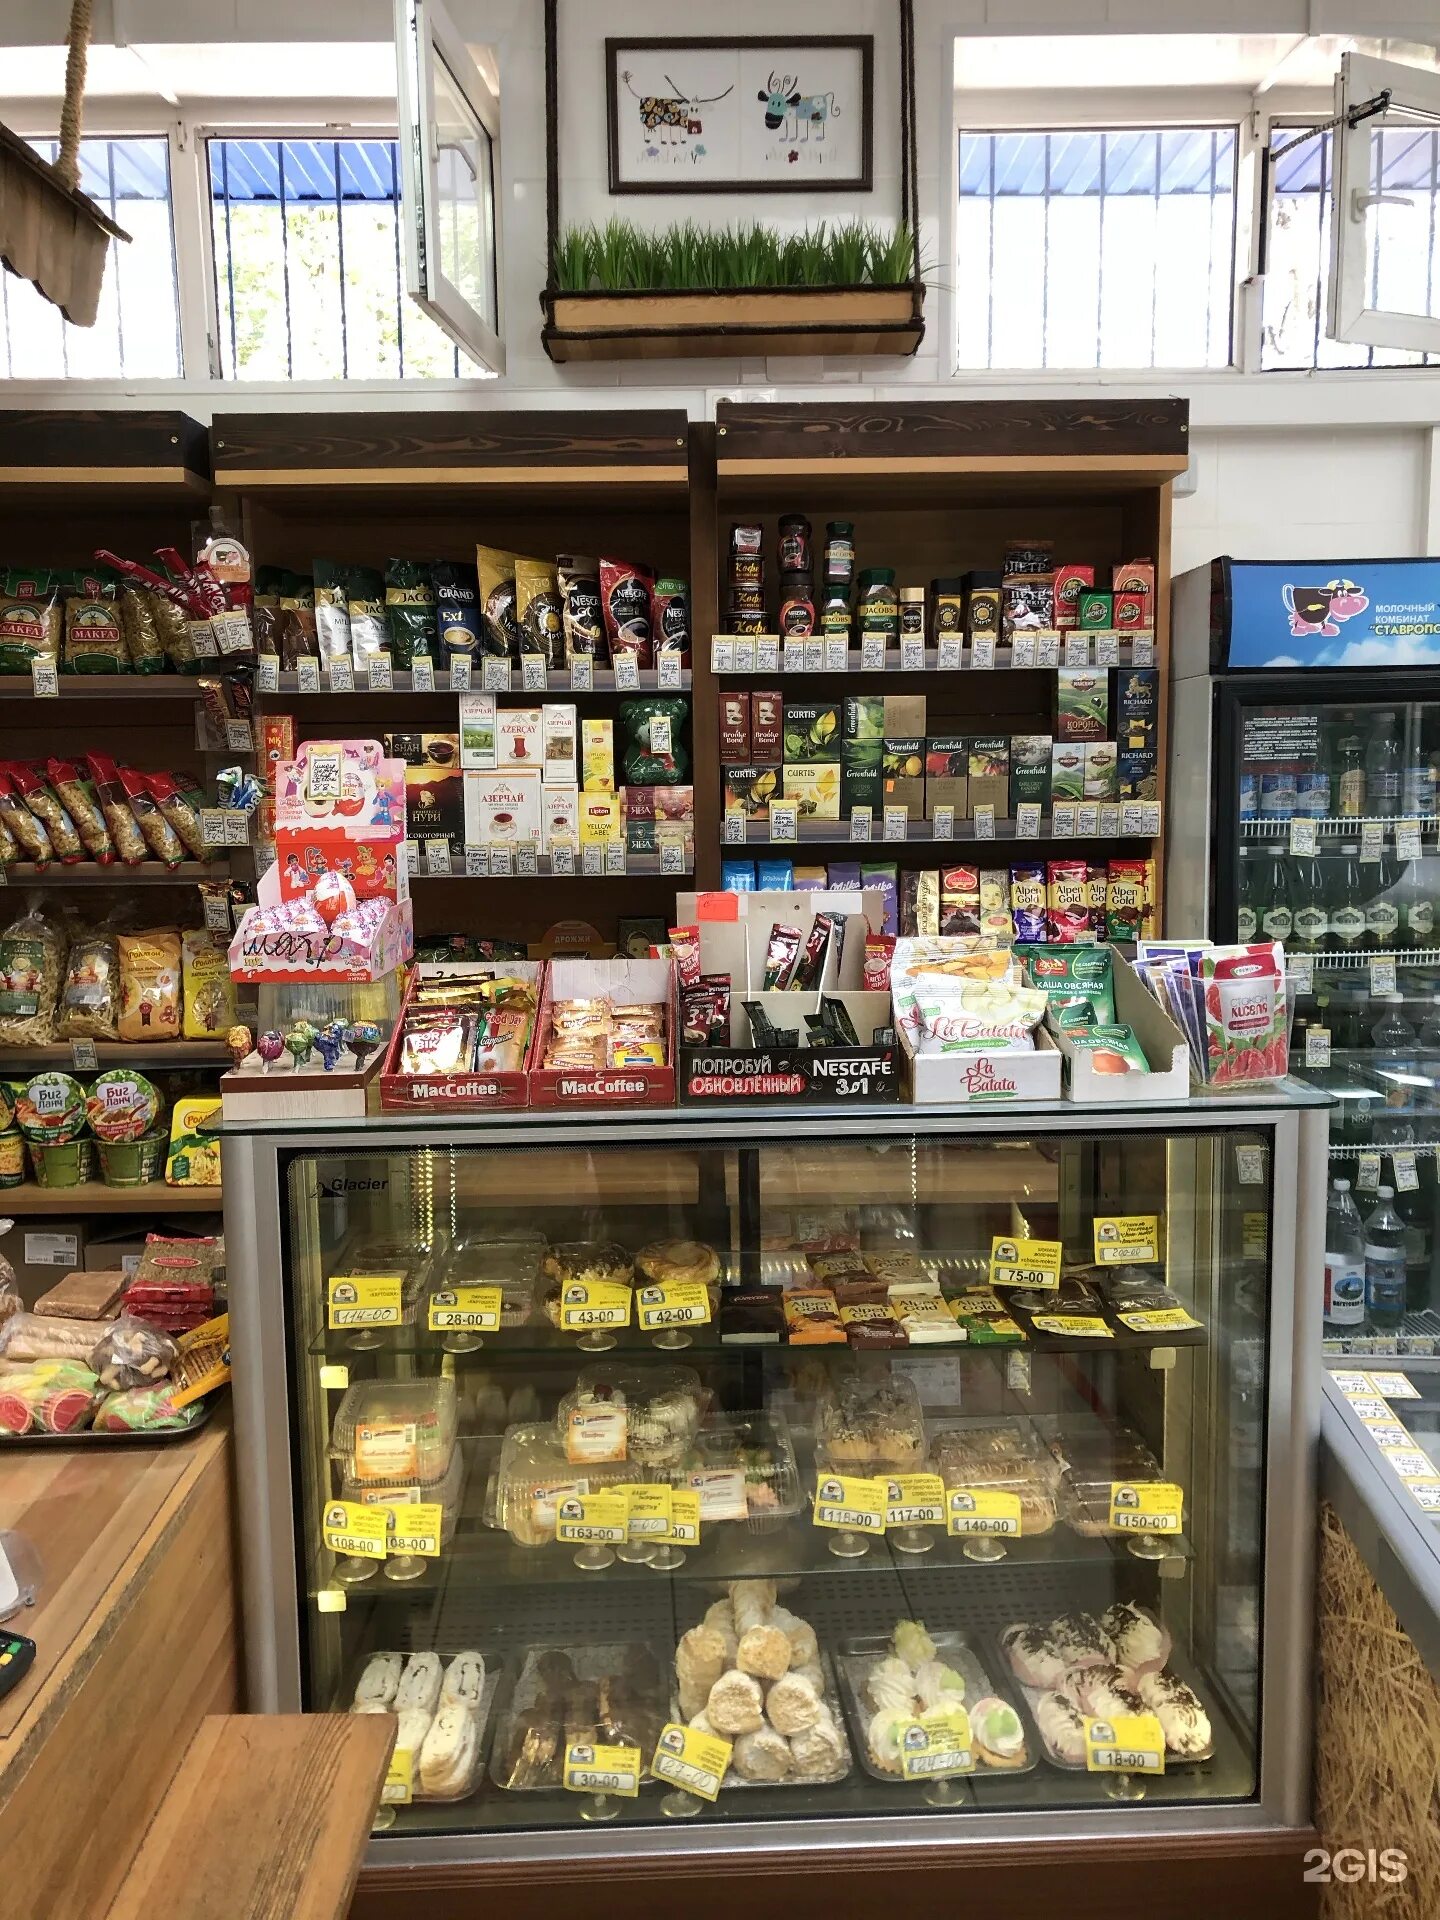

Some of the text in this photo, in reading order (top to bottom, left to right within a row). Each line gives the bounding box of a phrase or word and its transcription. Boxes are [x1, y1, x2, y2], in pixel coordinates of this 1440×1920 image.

[438, 588, 474, 600] GRAND
[1086, 608, 1108, 618] ЖОКЕЙ
[1376, 602, 1435, 613] МОЛОЧНЫЙ
[1119, 609, 1140, 618] ЖОКЕЙ
[1376, 614, 1430, 624] КОМБИНАТ
[74, 630, 116, 639] MAKFA
[788, 710, 816, 719] CURTIS
[848, 702, 857, 734] Greenfield
[1067, 720, 1099, 729] КОРОНА
[722, 730, 746, 738] Brooke
[756, 730, 779, 738] Brooke
[394, 743, 421, 752] SHAH
[888, 742, 919, 751] Greenfield
[932, 741, 962, 750] Greenfield
[974, 739, 1004, 749] Greenfield
[846, 769, 877, 778] Greenfield
[1016, 765, 1047, 776] Greenfield
[482, 794, 525, 802] АЗЕРЧАЙ
[412, 814, 442, 822] НУРИ
[830, 880, 860, 891] Milka
[1015, 886, 1042, 895] Alpen
[1056, 886, 1084, 894] Alpen
[1110, 886, 1138, 896] Alpen
[1017, 894, 1039, 903] Gold
[1058, 894, 1081, 903] Gold
[1112, 896, 1135, 905] Gold
[554, 935, 592, 944] ДРОЖЖИ
[1235, 966, 1260, 974] PREMIUM
[1037, 981, 1104, 990] КАША ОВСЯНАЯ
[1088, 1039, 1130, 1050] ОВСЯНАЯ
[692, 1056, 772, 1074] ПОПРОБУЙ
[966, 1058, 995, 1078] La
[562, 1080, 645, 1096] MacCoffee
[692, 1074, 801, 1094] ОБНОВЛЁННЫЙ
[960, 1074, 1017, 1093] Batata
[38, 1090, 62, 1101] Биг
[106, 1086, 130, 1098] Биг
[412, 1082, 498, 1098] MacCoffee
[332, 1178, 389, 1191] Glacier
[1008, 1270, 1044, 1283] 75-00
[900, 1300, 939, 1308] Alpen
[342, 1309, 392, 1324] 114-00
[446, 1314, 483, 1326] 28-00
[578, 1310, 614, 1323] 43-00
[656, 1308, 693, 1322] 42-00
[890, 1509, 934, 1521] 117-00
[964, 1520, 1009, 1533] 140-00
[1124, 1516, 1168, 1528] 150-00
[570, 1527, 614, 1540] 163-00
[334, 1538, 374, 1552] 108-00
[1106, 1752, 1145, 1767] 18-00
[580, 1774, 620, 1788] 30-00
